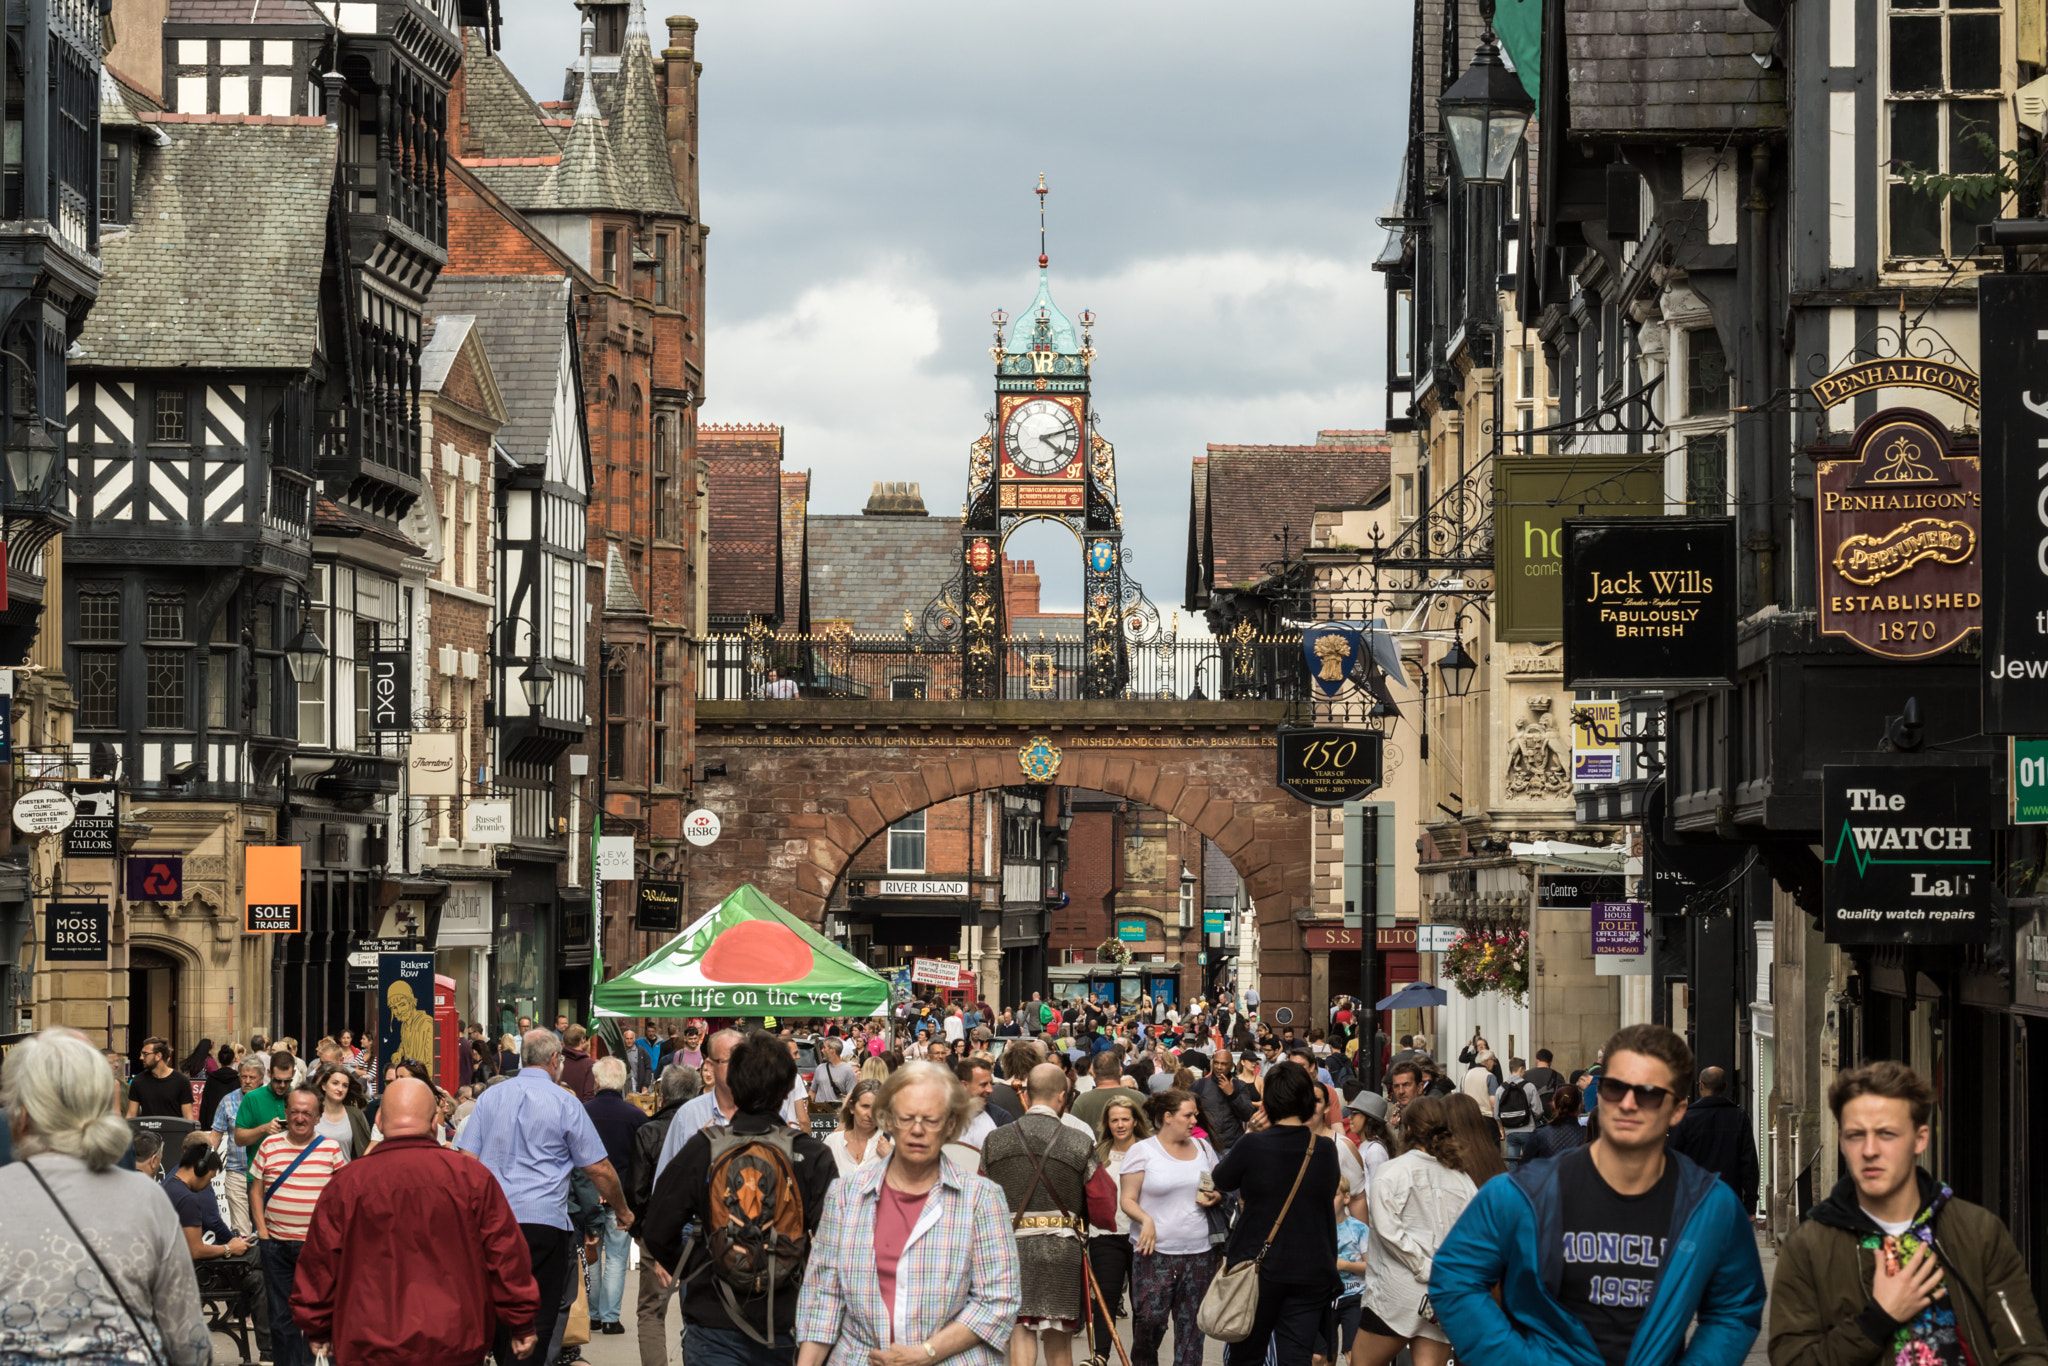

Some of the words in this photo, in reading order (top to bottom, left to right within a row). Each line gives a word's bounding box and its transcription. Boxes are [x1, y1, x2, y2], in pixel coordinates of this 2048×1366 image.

[1001, 463, 1016, 478] 18
[1066, 463, 1083, 478] 97
[1849, 530, 1962, 570] PERFUMERS
[1587, 570, 1642, 602] Jack
[1650, 570, 1713, 595] Wills
[1623, 598, 1648, 606] London
[1652, 598, 1681, 608] England
[1832, 593, 1981, 612] ESTABLISHED
[1601, 609, 1699, 622] FABULOUSLY
[1616, 624, 1684, 637] BRITISH
[1879, 621, 1936, 642] 1870
[377, 662, 396, 724] next
[721, 736, 743, 745] THIS
[746, 736, 770, 745] GATE
[773, 736, 804, 745] BEGUN
[884, 737, 907, 747] JOHN
[910, 737, 953, 745] KELSALL
[976, 737, 1012, 746] MAYOR
[1071, 737, 1114, 746] FINISHED
[1210, 737, 1259, 746] BOSWELL
[1587, 724, 1608, 746] TO
[1303, 736, 1357, 770] 150
[1846, 788, 1906, 811] The
[71, 820, 114, 828] HESTER
[475, 815, 502, 824] Russell
[73, 830, 108, 839] CLOCK
[687, 826, 717, 838] HSBC
[1852, 827, 1971, 850] WATCH
[69, 841, 112, 849] TAILORS
[885, 882, 918, 894] RIVER
[921, 882, 964, 894] ISLAND
[1551, 882, 1577, 897] Centre
[255, 906, 291, 919] SOLE
[1837, 908, 1883, 921] Quality
[1886, 908, 1925, 920] watch
[1928, 908, 1975, 922] repairs
[56, 918, 97, 930] MOSS
[255, 921, 291, 930] TRADER
[1599, 921, 1615, 931] TO
[1617, 921, 1638, 931] LET
[56, 931, 101, 943] BROS.
[400, 969, 419, 978] Row
[640, 990, 682, 1008] Live
[691, 988, 725, 1012] life
[732, 990, 758, 1006] on
[766, 988, 799, 1006] the
[807, 991, 842, 1012] veg
